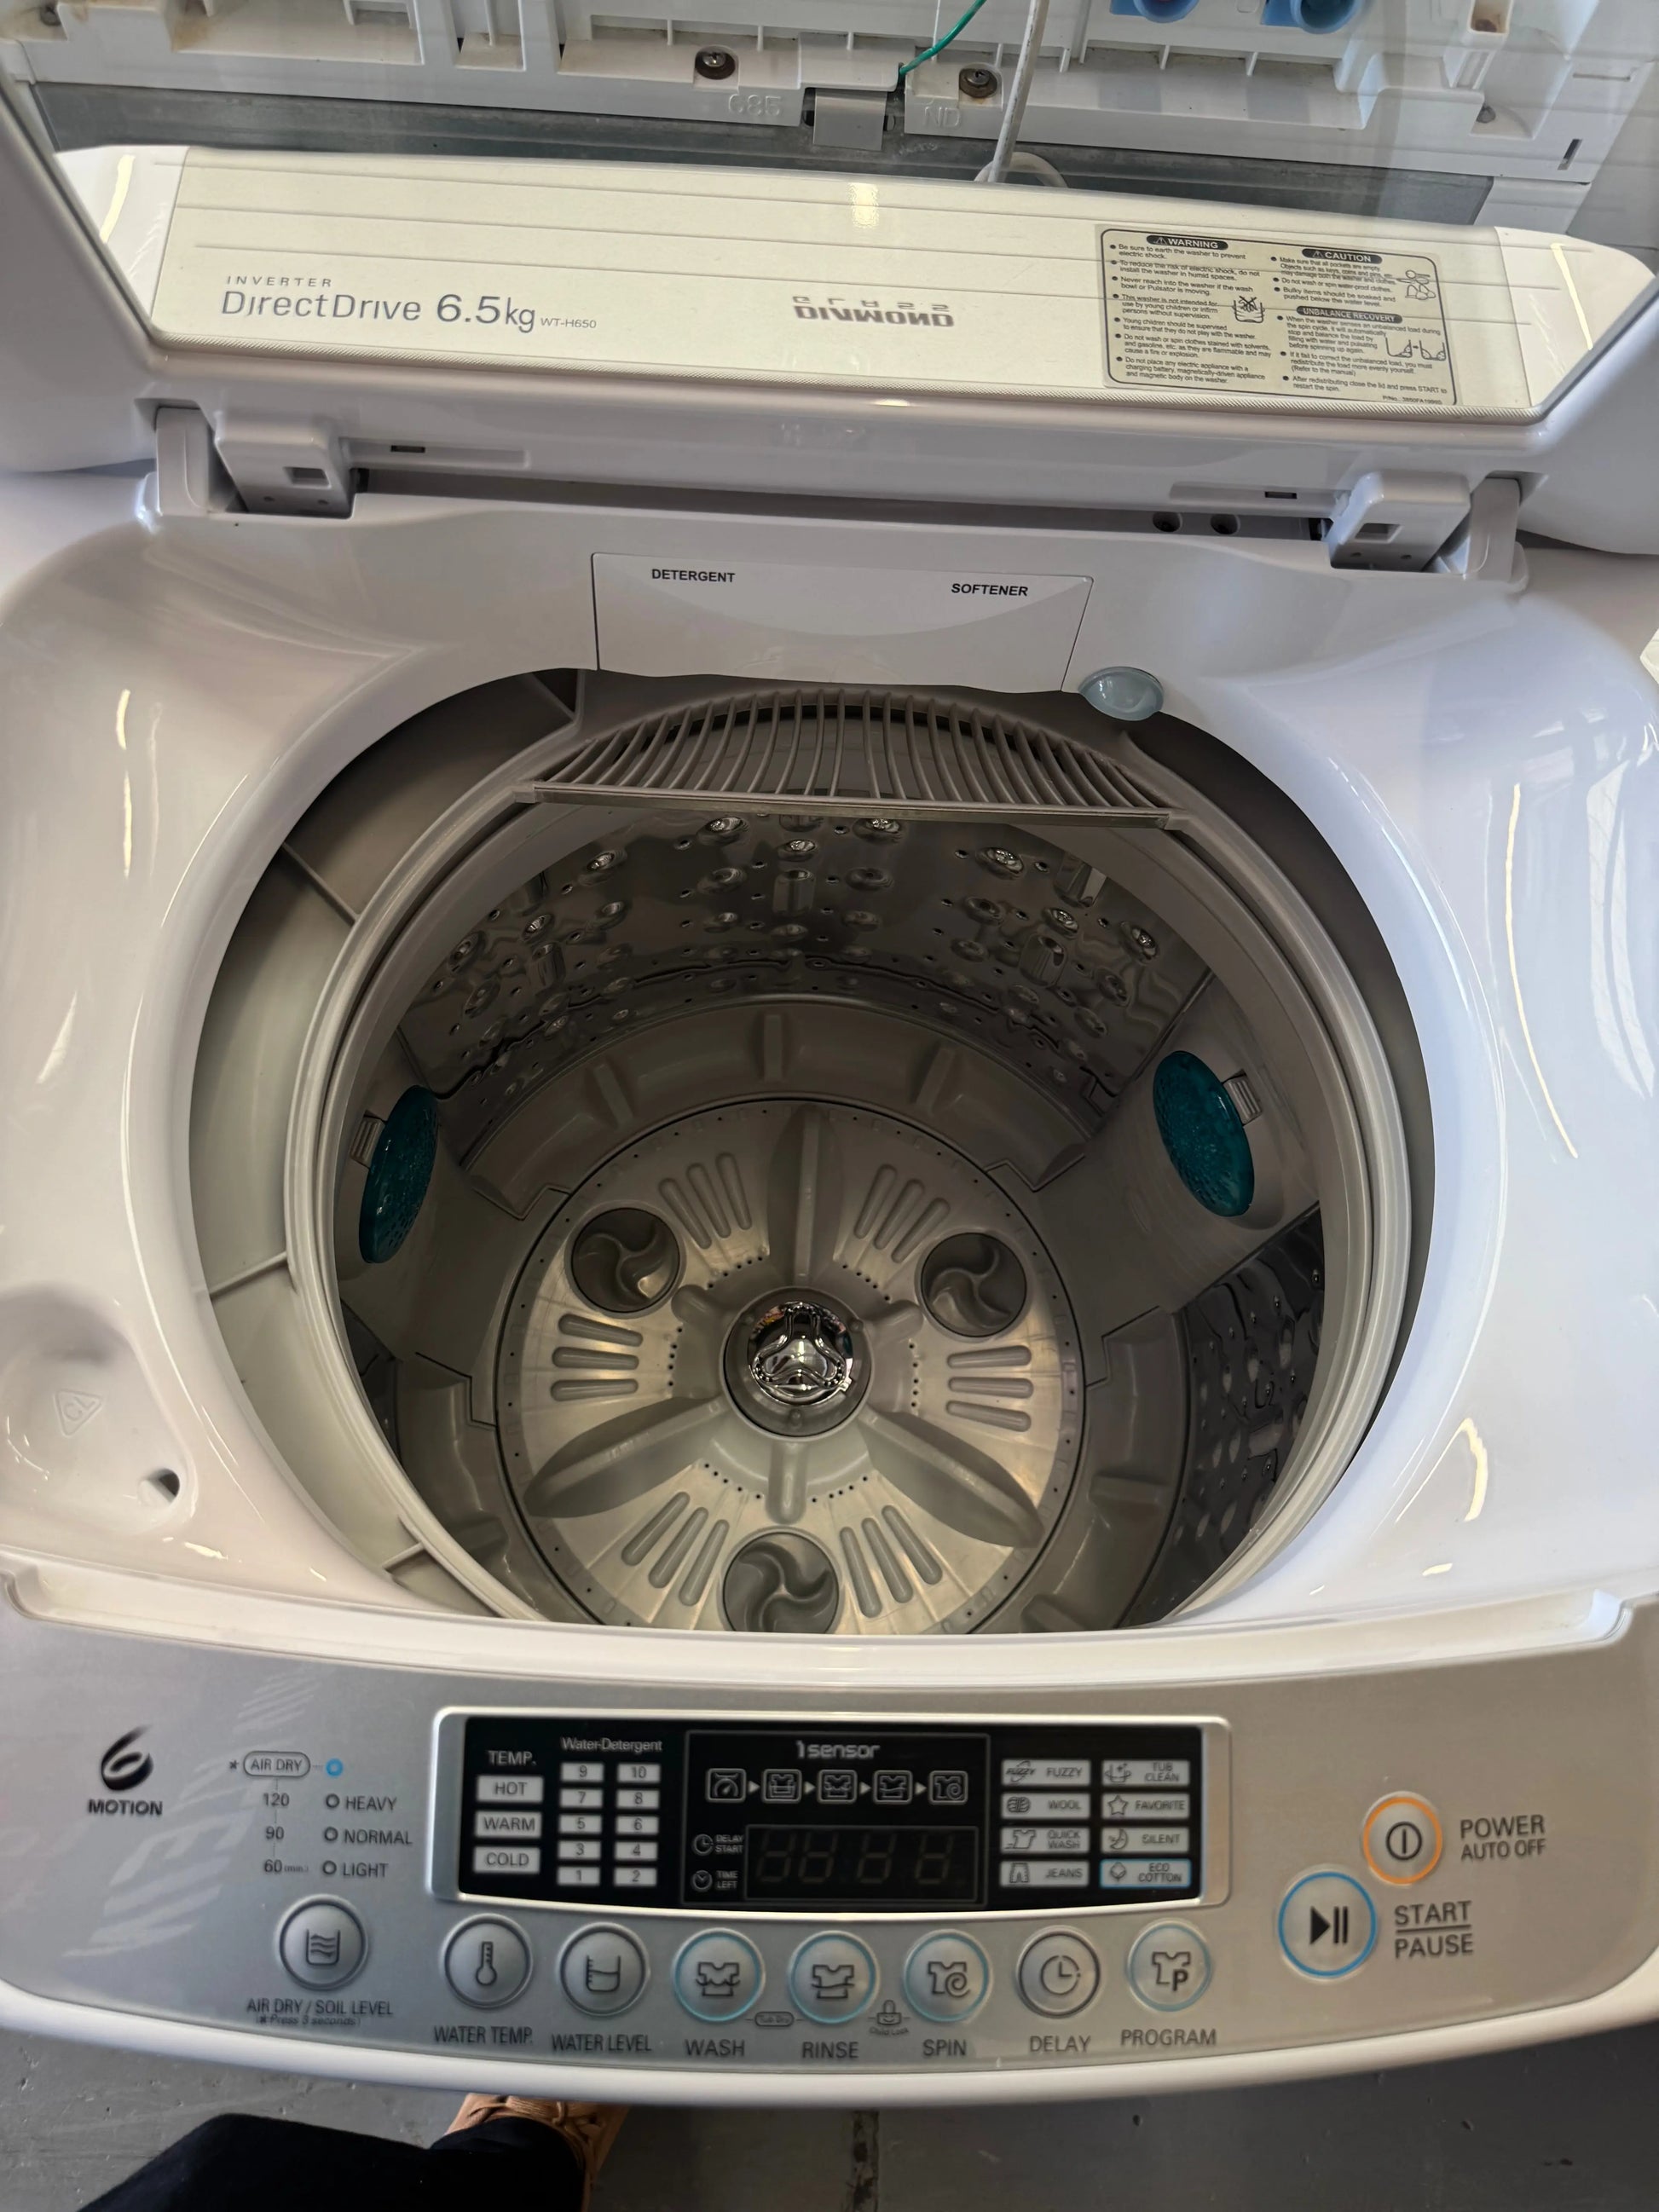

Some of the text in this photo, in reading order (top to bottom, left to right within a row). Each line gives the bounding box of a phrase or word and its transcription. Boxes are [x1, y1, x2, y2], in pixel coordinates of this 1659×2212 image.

[1167, 238, 1219, 249] WARNING
[1324, 251, 1372, 263] CAUTION
[226, 276, 332, 287] INVERTER
[1303, 307, 1396, 322] UNBALANCE RECOVERY
[540, 317, 597, 329] WT-H650
[651, 569, 736, 582] DETERGENT
[951, 583, 1028, 597] SOFTENER
[488, 1750, 536, 1765] TEMP.
[251, 1758, 302, 1772] AIR DRY
[579, 1764, 588, 1778] 9
[630, 1765, 647, 1779] 10
[1046, 1767, 1083, 1777] FUZZY
[1153, 1762, 1174, 1772] TUB
[1143, 1772, 1180, 1782] CLEAN
[494, 1781, 528, 1795] HOT
[263, 1793, 289, 1807] 120
[345, 1796, 397, 1811] HEAVY
[577, 1791, 587, 1804] 7
[634, 1792, 644, 1805] 8
[1047, 1799, 1082, 1810] WOOL
[88, 1799, 163, 1816] MOTION
[1134, 1799, 1185, 1811] FAVORITE
[483, 1816, 535, 1831] WARM
[576, 1816, 586, 1830] 5
[633, 1817, 643, 1830] 6
[1460, 1814, 1545, 1839] POWER
[265, 1826, 285, 1840] 90
[344, 1829, 413, 1845] NORMAL
[716, 1834, 744, 1843] DELAY
[1047, 1829, 1081, 1839] QUICK
[1142, 1834, 1181, 1844] SILENT
[575, 1843, 585, 1856] 3
[632, 1843, 641, 1856] 4
[715, 1845, 743, 1853] START
[1047, 1839, 1081, 1849] WASH
[1460, 1838, 1546, 1861] AUTO OFF
[485, 1851, 529, 1866] COLD
[263, 1859, 282, 1874] 60
[342, 1863, 389, 1878] LIGHT
[1045, 1868, 1084, 1879] JEANS
[1148, 1863, 1171, 1872] ECO
[575, 1869, 582, 1882] 1
[631, 1869, 641, 1882] 2
[716, 1870, 738, 1879] TIME
[1137, 1873, 1182, 1883] COTTON
[716, 1880, 738, 1889] LEFT
[1394, 1900, 1472, 1926] START
[1395, 1932, 1474, 1959] PAUSE
[247, 1998, 393, 2015] AIR DRY / SOIL LEVEL
[433, 2025, 533, 2045] WATER TEMP.
[1120, 2029, 1217, 2047] PROGRAM
[552, 2034, 652, 2052] WATER LEVEL
[685, 2039, 746, 2057] WASH
[801, 2041, 859, 2059] RINSE
[922, 2038, 967, 2057] SPIN
[1029, 2035, 1091, 2053] DELAY
